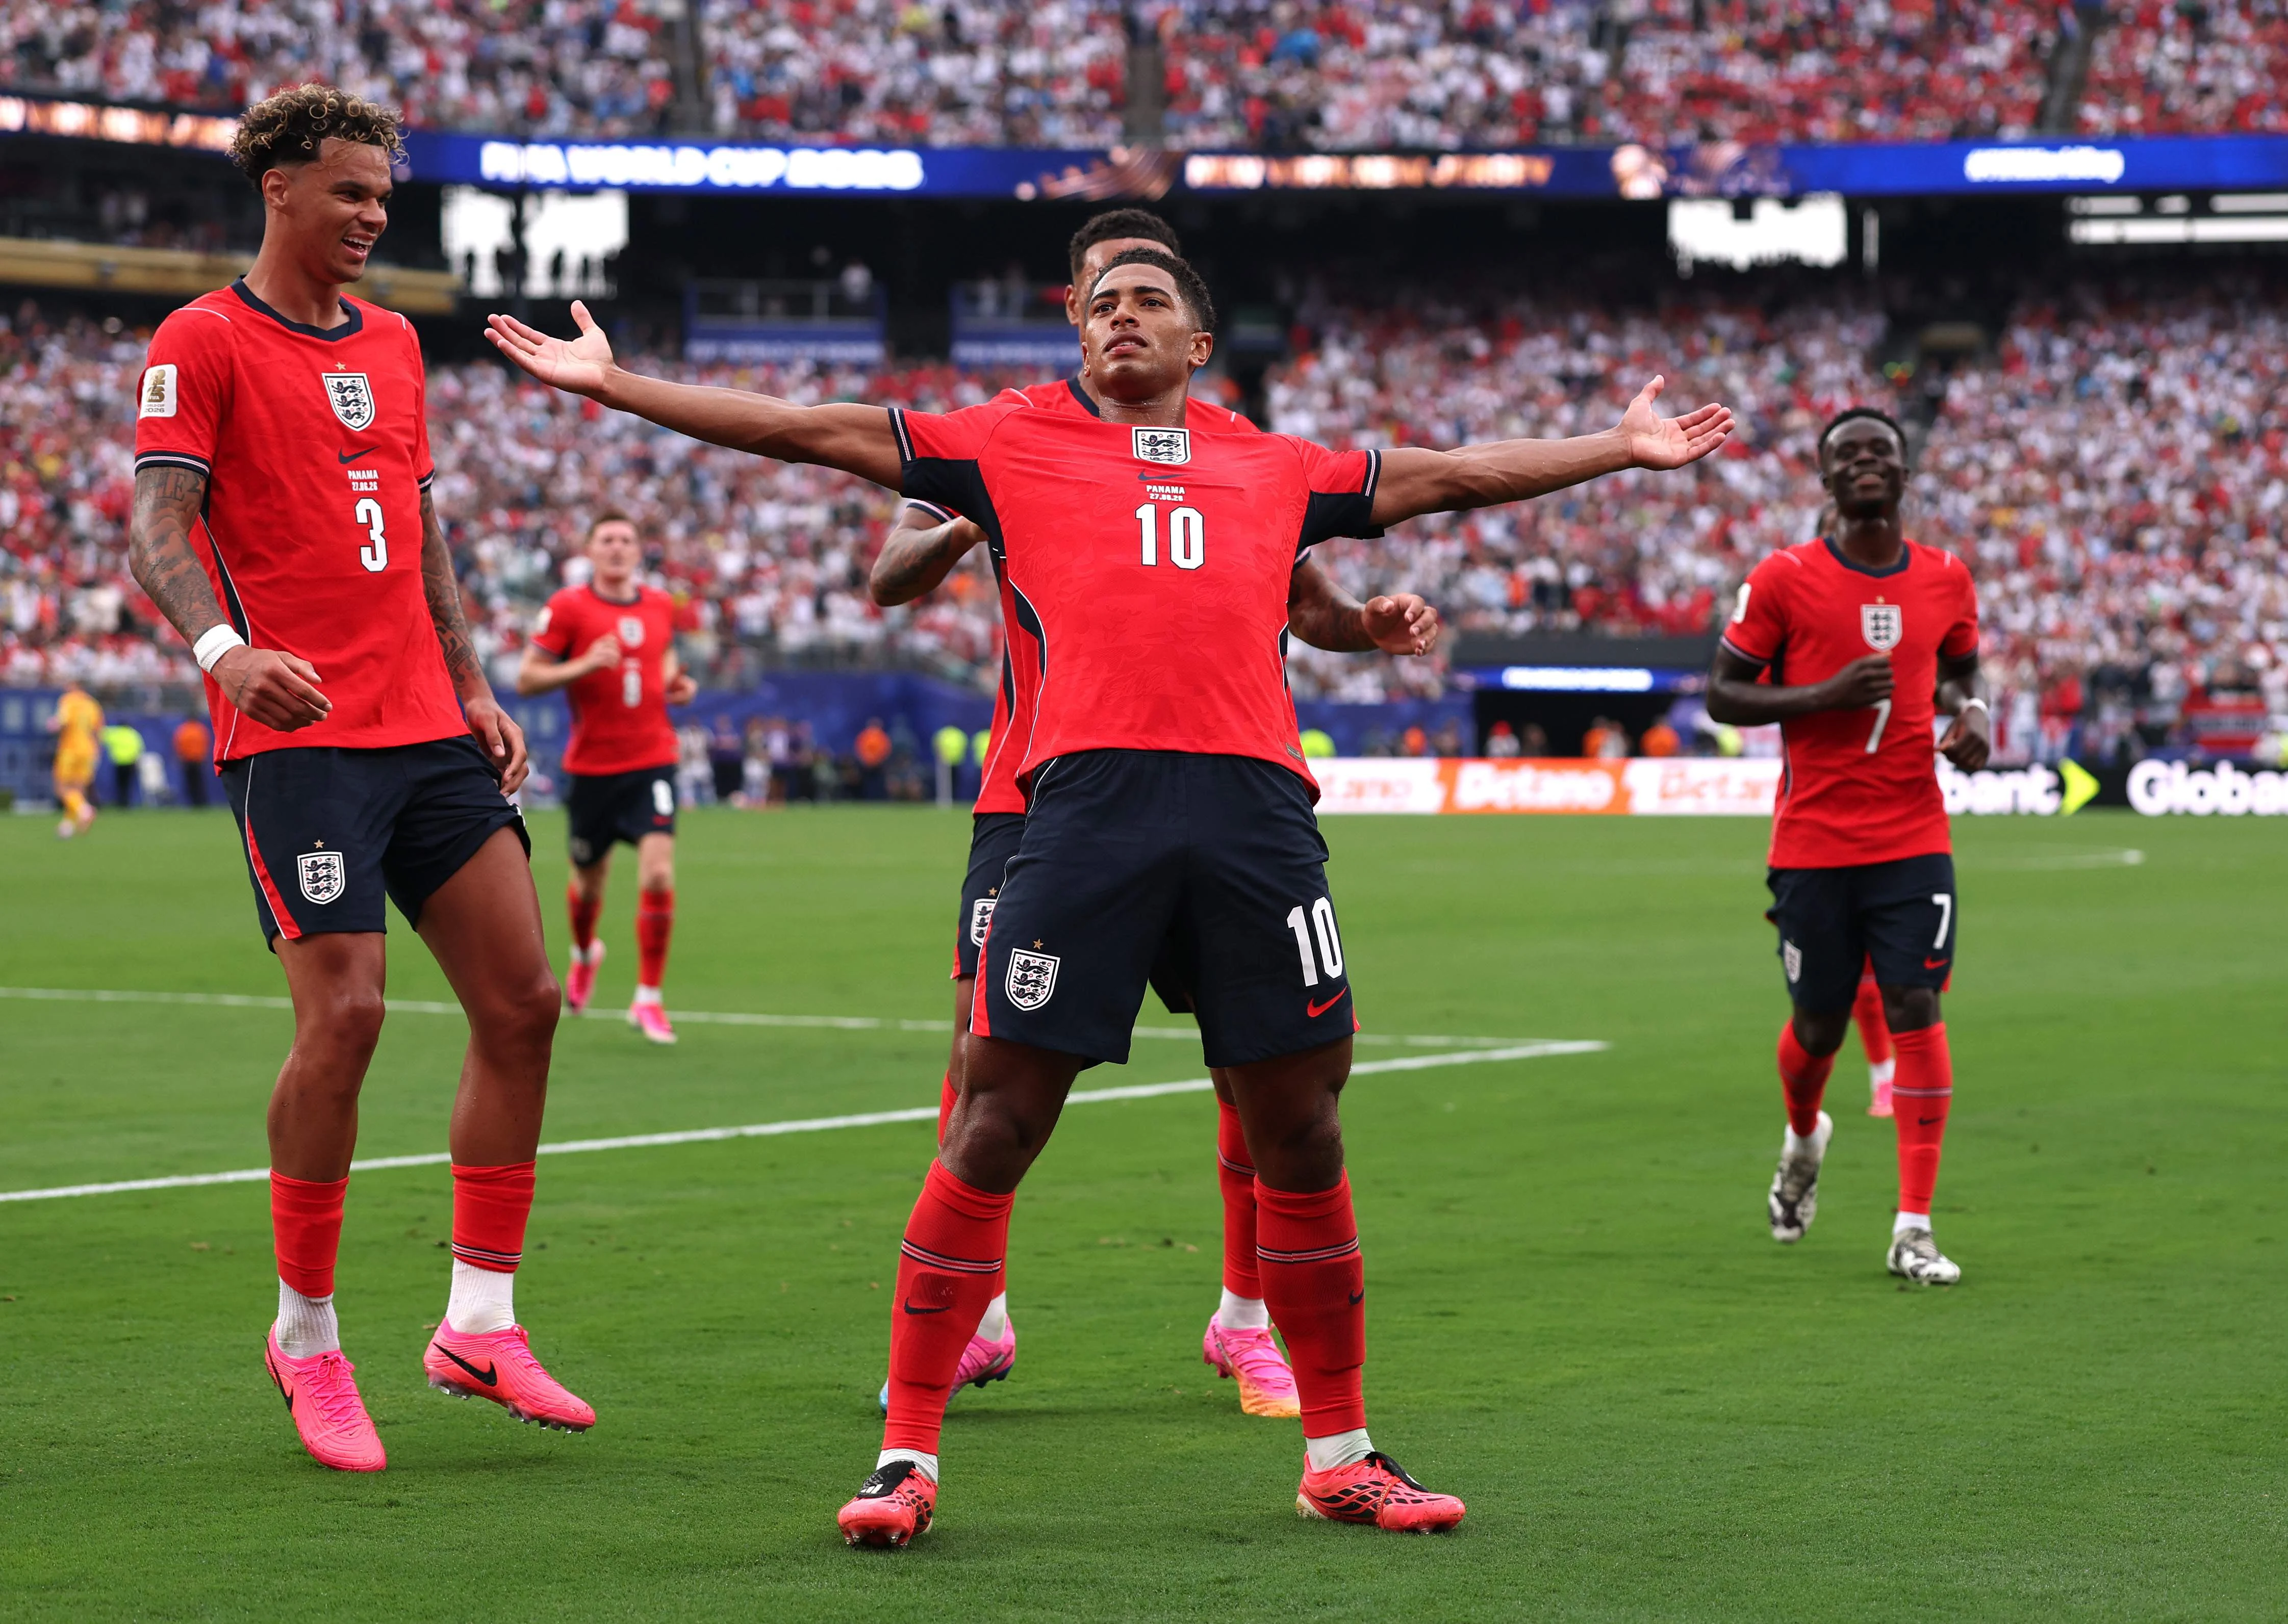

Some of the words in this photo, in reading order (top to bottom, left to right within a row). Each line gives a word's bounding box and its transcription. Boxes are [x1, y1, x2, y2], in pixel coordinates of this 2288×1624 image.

[347, 470, 378, 479] PANAMA
[352, 481, 378, 491] 27.06.26
[1146, 485, 1185, 494] PANAMA
[1150, 493, 1183, 502] 27.06.26
[354, 497, 389, 572] 3
[1135, 503, 1205, 570] 10
[1865, 698, 1892, 754] 7
[1455, 763, 1616, 810] Betano
[1936, 759, 2061, 816] bant
[2127, 760, 2288, 817] Globa
[1286, 895, 1343, 987] 10
[1931, 893, 1951, 949] 7
